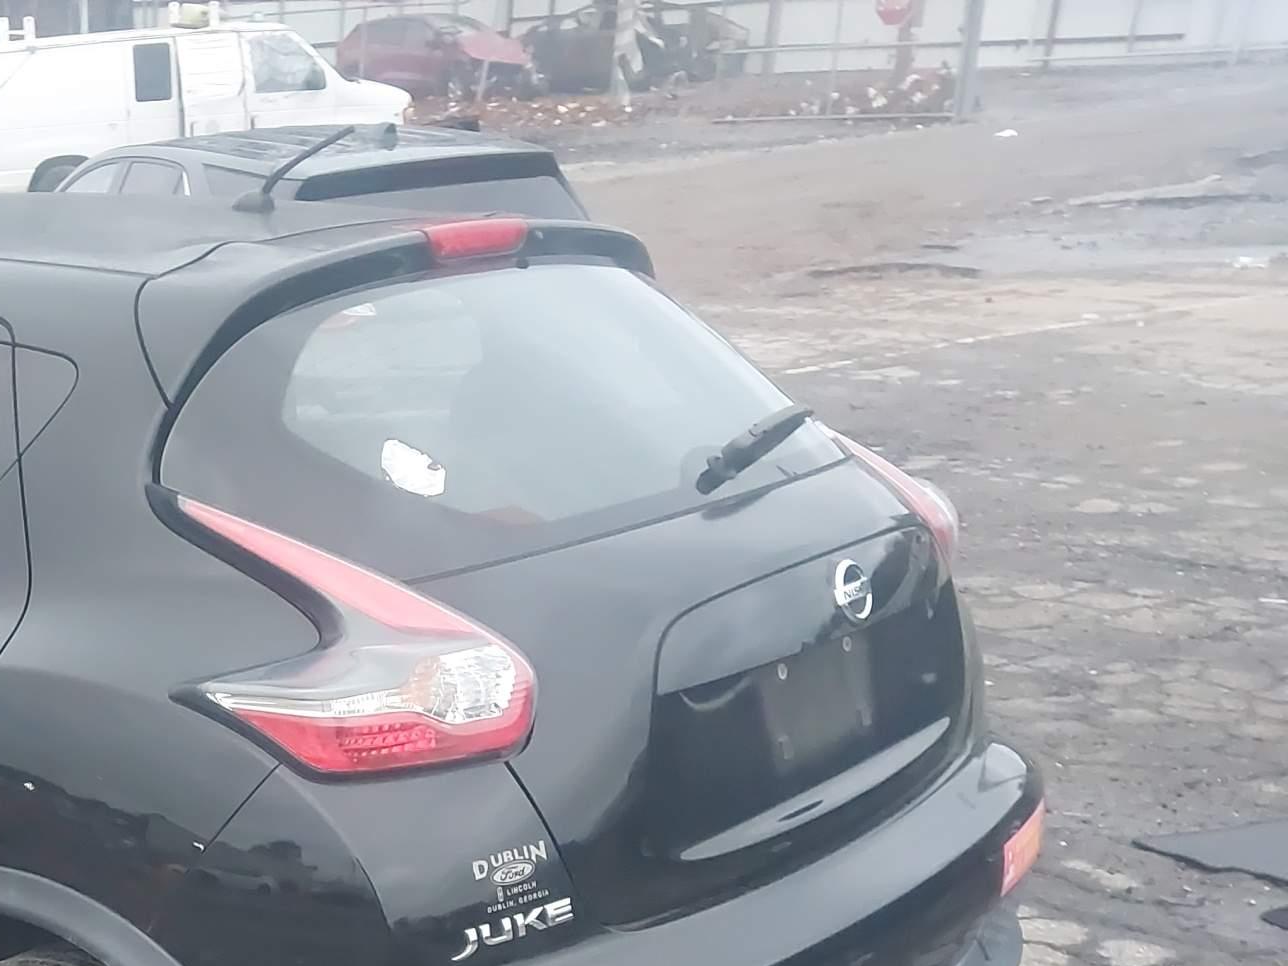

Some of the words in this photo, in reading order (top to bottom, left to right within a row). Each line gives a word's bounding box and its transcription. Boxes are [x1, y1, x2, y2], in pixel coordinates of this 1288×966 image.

[472, 840, 547, 880] DUBLIN
[506, 881, 537, 896] LINCOLN
[518, 889, 549, 904] GEORGIA
[451, 897, 574, 961] JUKE
